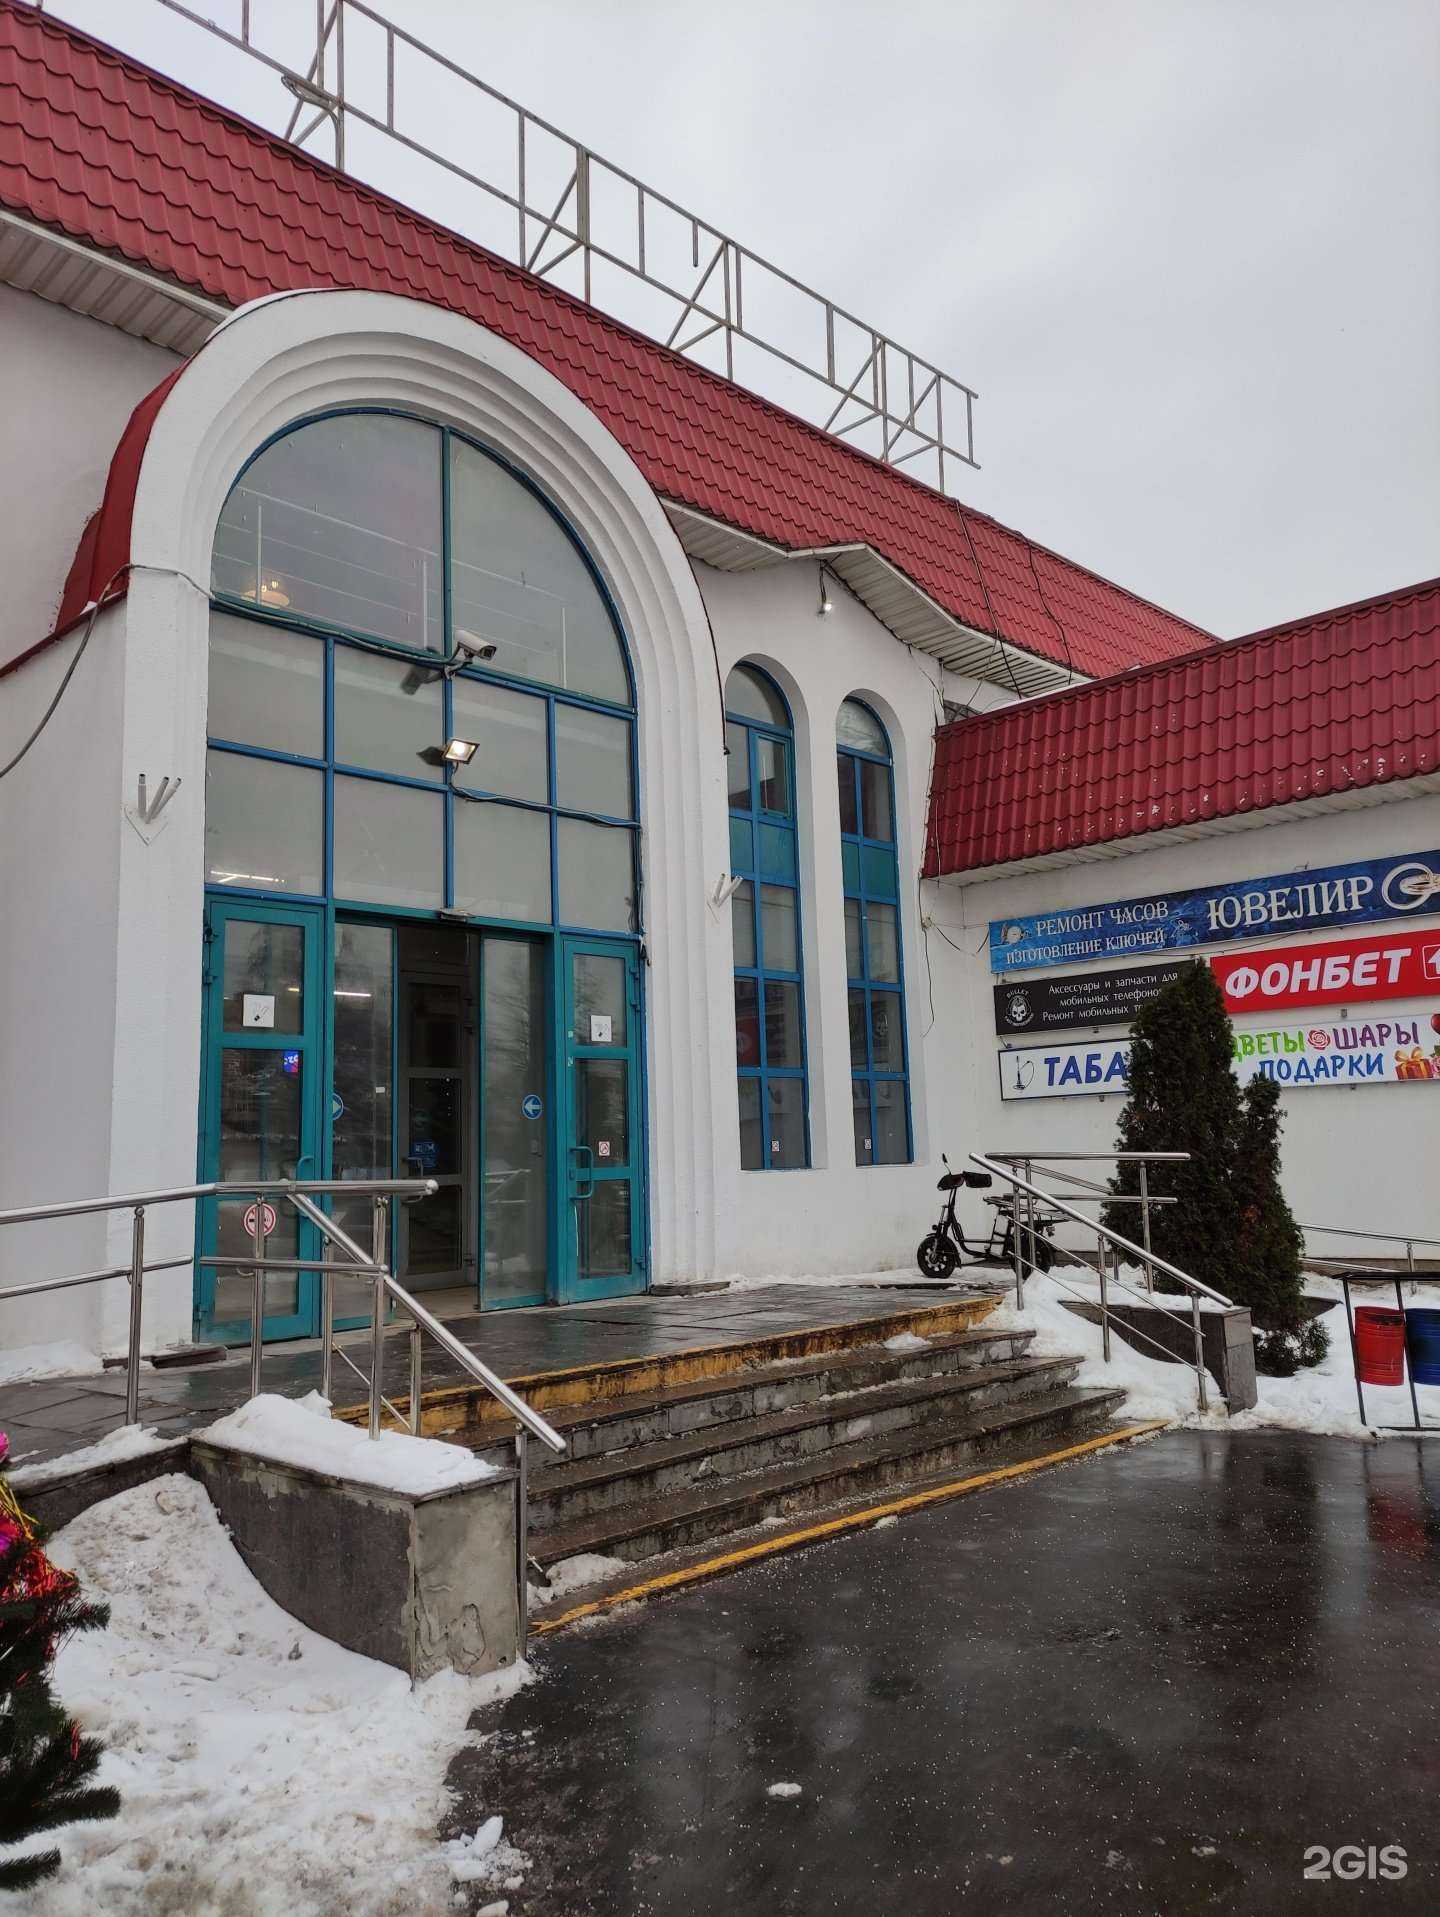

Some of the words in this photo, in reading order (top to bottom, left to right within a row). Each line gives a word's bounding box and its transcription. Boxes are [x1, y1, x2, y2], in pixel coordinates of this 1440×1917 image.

[1035, 910, 1106, 938] РЕМОНТ
[1110, 901, 1169, 925] ЧАСОВ
[1206, 875, 1374, 931] ЮВЕЛИР
[1006, 938, 1103, 964] ИЗГОТОВЛЕНИЕ
[1105, 928, 1165, 951] КЛЮЧЕЙ
[1048, 980, 1101, 995] Аксессуары
[1104, 980, 1111, 988] и
[1114, 975, 1157, 988] запчасти
[1161, 972, 1178, 982] для
[1225, 948, 1412, 999] ФОНБЕТ
[1042, 1011, 1074, 1023] Ремонт
[1078, 1005, 1129, 1018] мобильных
[1059, 993, 1109, 1007] мобильных
[1332, 1021, 1420, 1050] ШАРЫ
[1044, 1051, 1128, 1087] ТАБА
[1258, 1052, 1384, 1083] ПОДАРКИ
